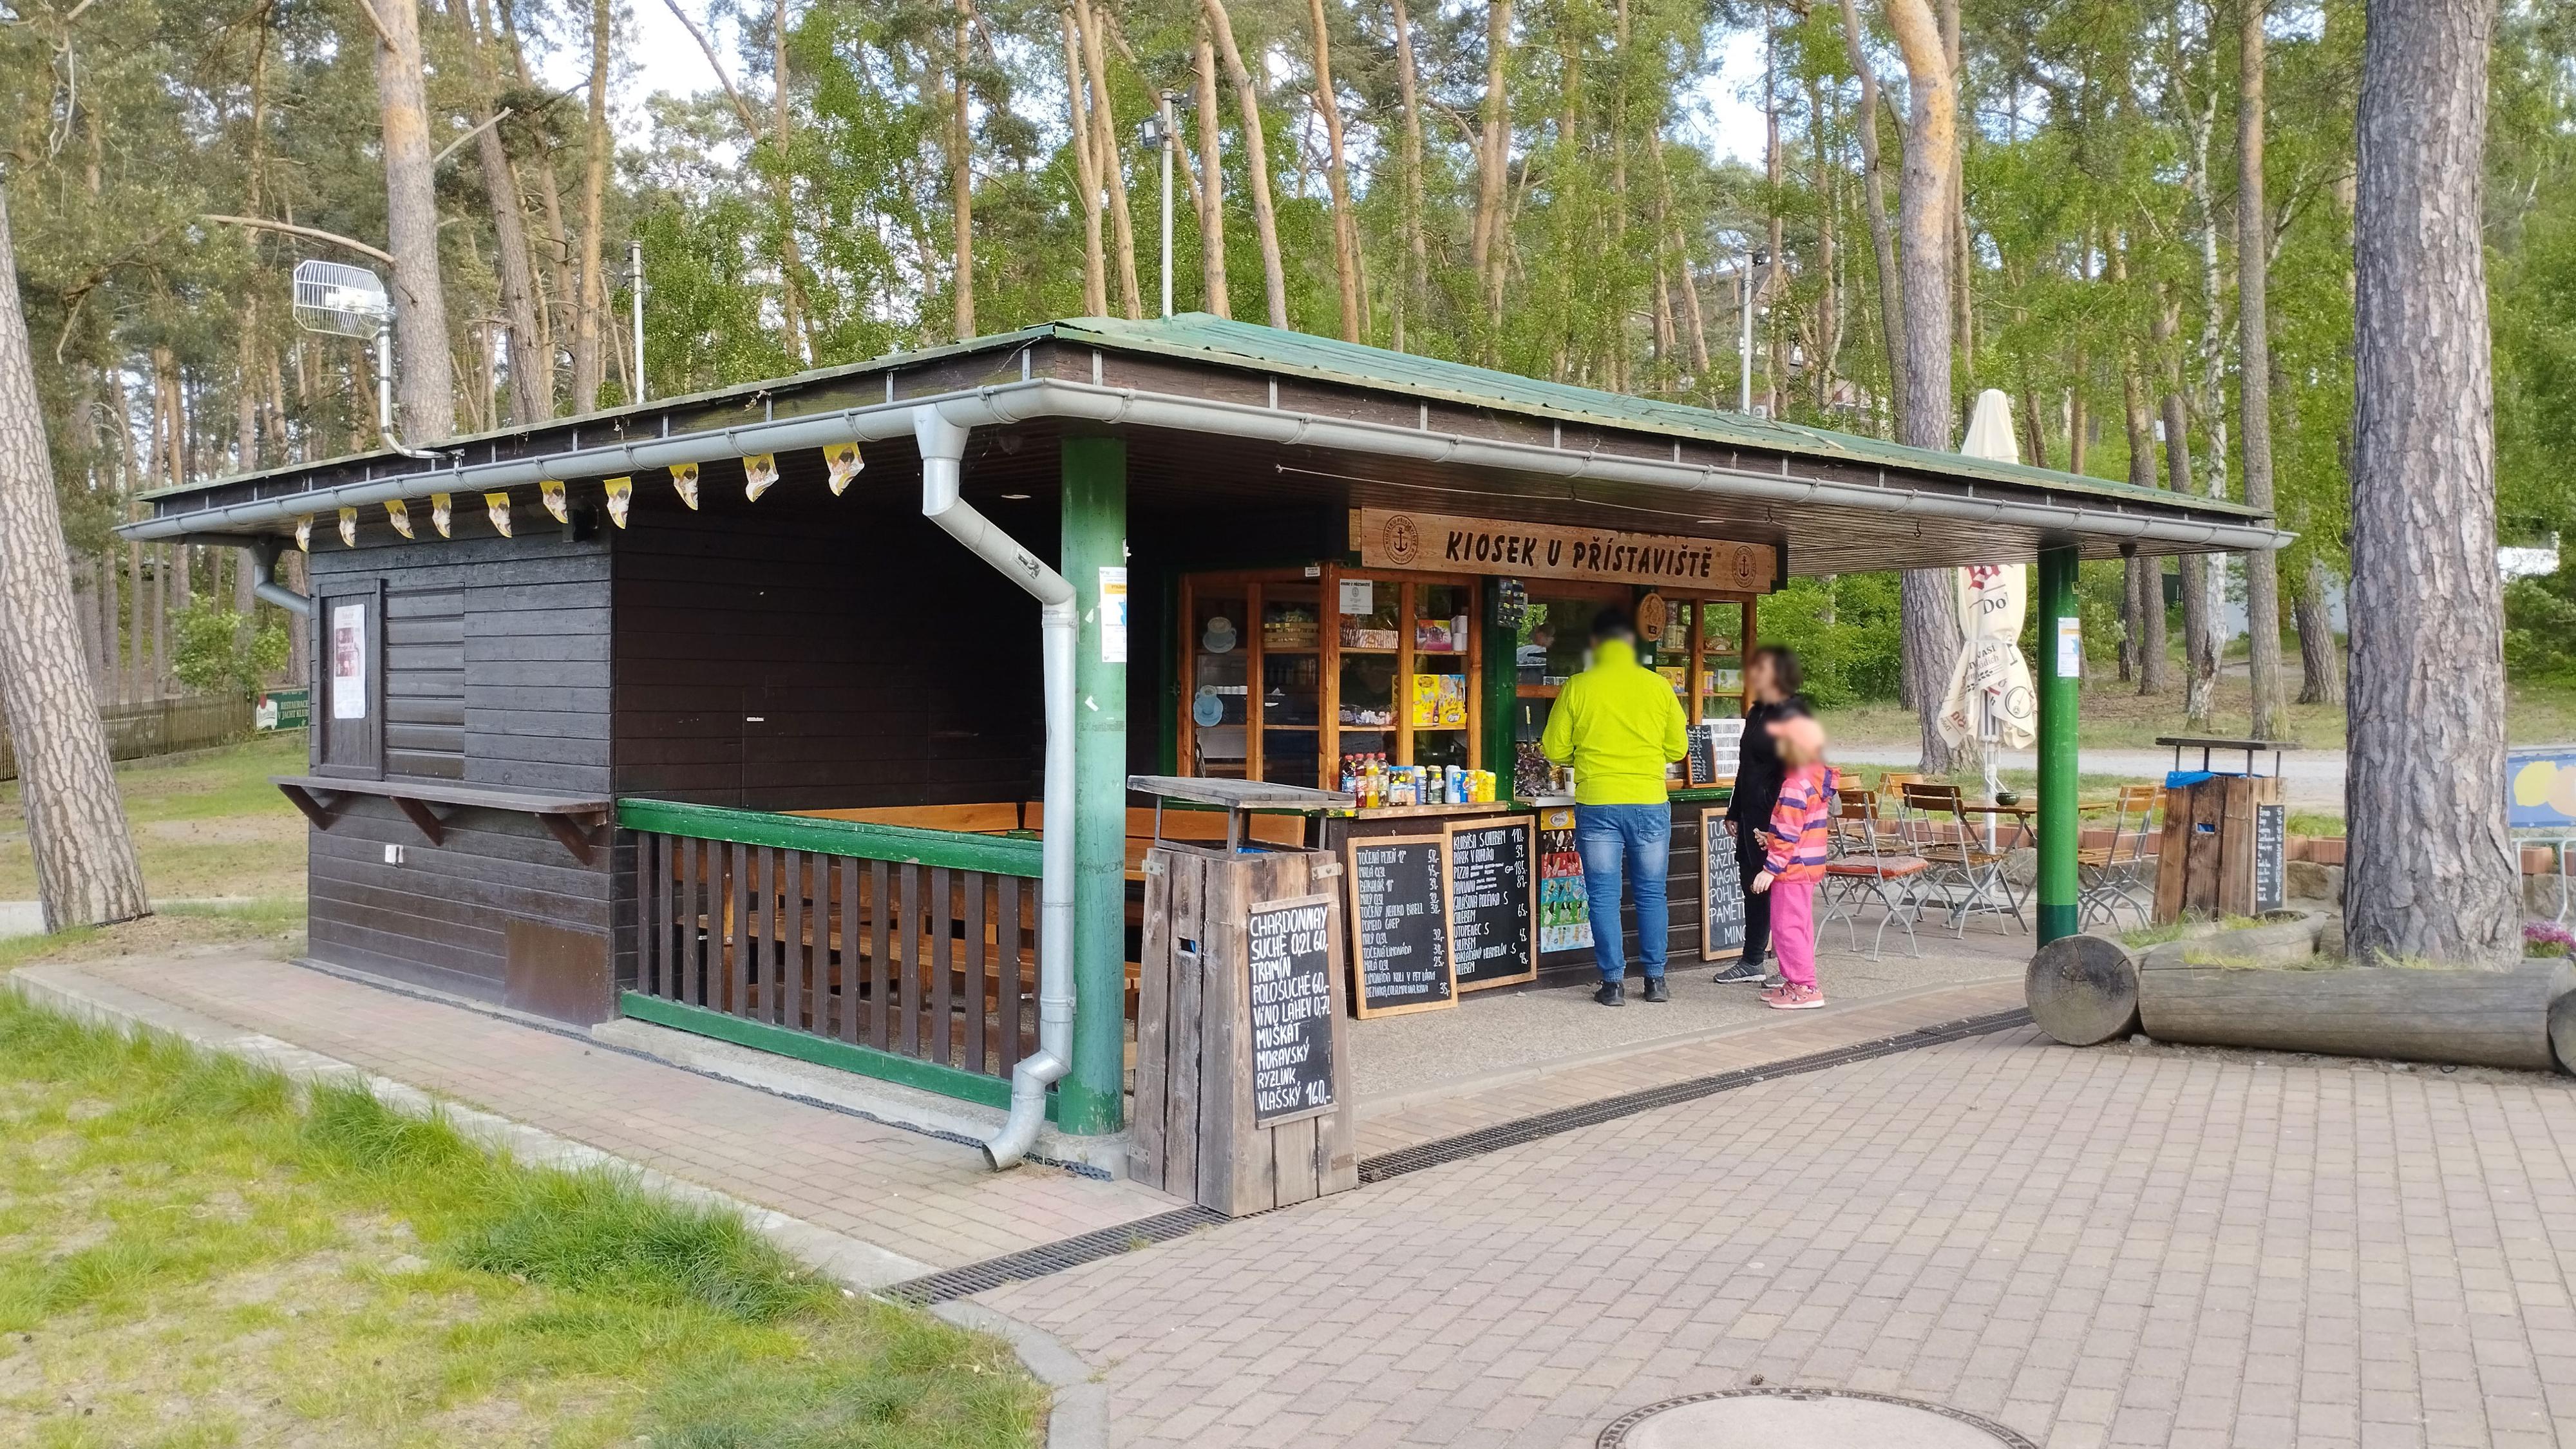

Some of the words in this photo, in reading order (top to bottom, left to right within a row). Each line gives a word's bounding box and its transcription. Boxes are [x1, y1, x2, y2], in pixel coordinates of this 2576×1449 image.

[1446, 531, 1537, 567] KIOSEK
[1547, 539, 1562, 567] U
[1573, 536, 1712, 578] PŘÍSTAVIŠTĚ
[1454, 866, 1469, 879] PIZZA
[1709, 848, 1739, 869] RAZÍT
[1504, 891, 1508, 905] S
[1250, 906, 1327, 936] CHARDONNAY
[1484, 922, 1489, 935] S
[1251, 933, 1287, 960] SUCHÉ
[1291, 931, 1312, 957] 0,2L
[1314, 930, 1329, 952] 60,-
[1250, 956, 1291, 983] TRAMÍN
[1253, 971, 1311, 1005] POLOSUCHÉ
[1312, 972, 1329, 994] 60,-
[1282, 997, 1312, 1022] LÁHEV
[1314, 996, 1331, 1018] 0,7L
[1256, 1020, 1300, 1049] MUŠKÁT
[1257, 1036, 1309, 1071] MORAVSKÝ
[1258, 1068, 1296, 1089] RYZLINK
[1258, 1081, 1301, 1112] VLAŠSKÝ
[1306, 1079, 1331, 1106] 160,-
